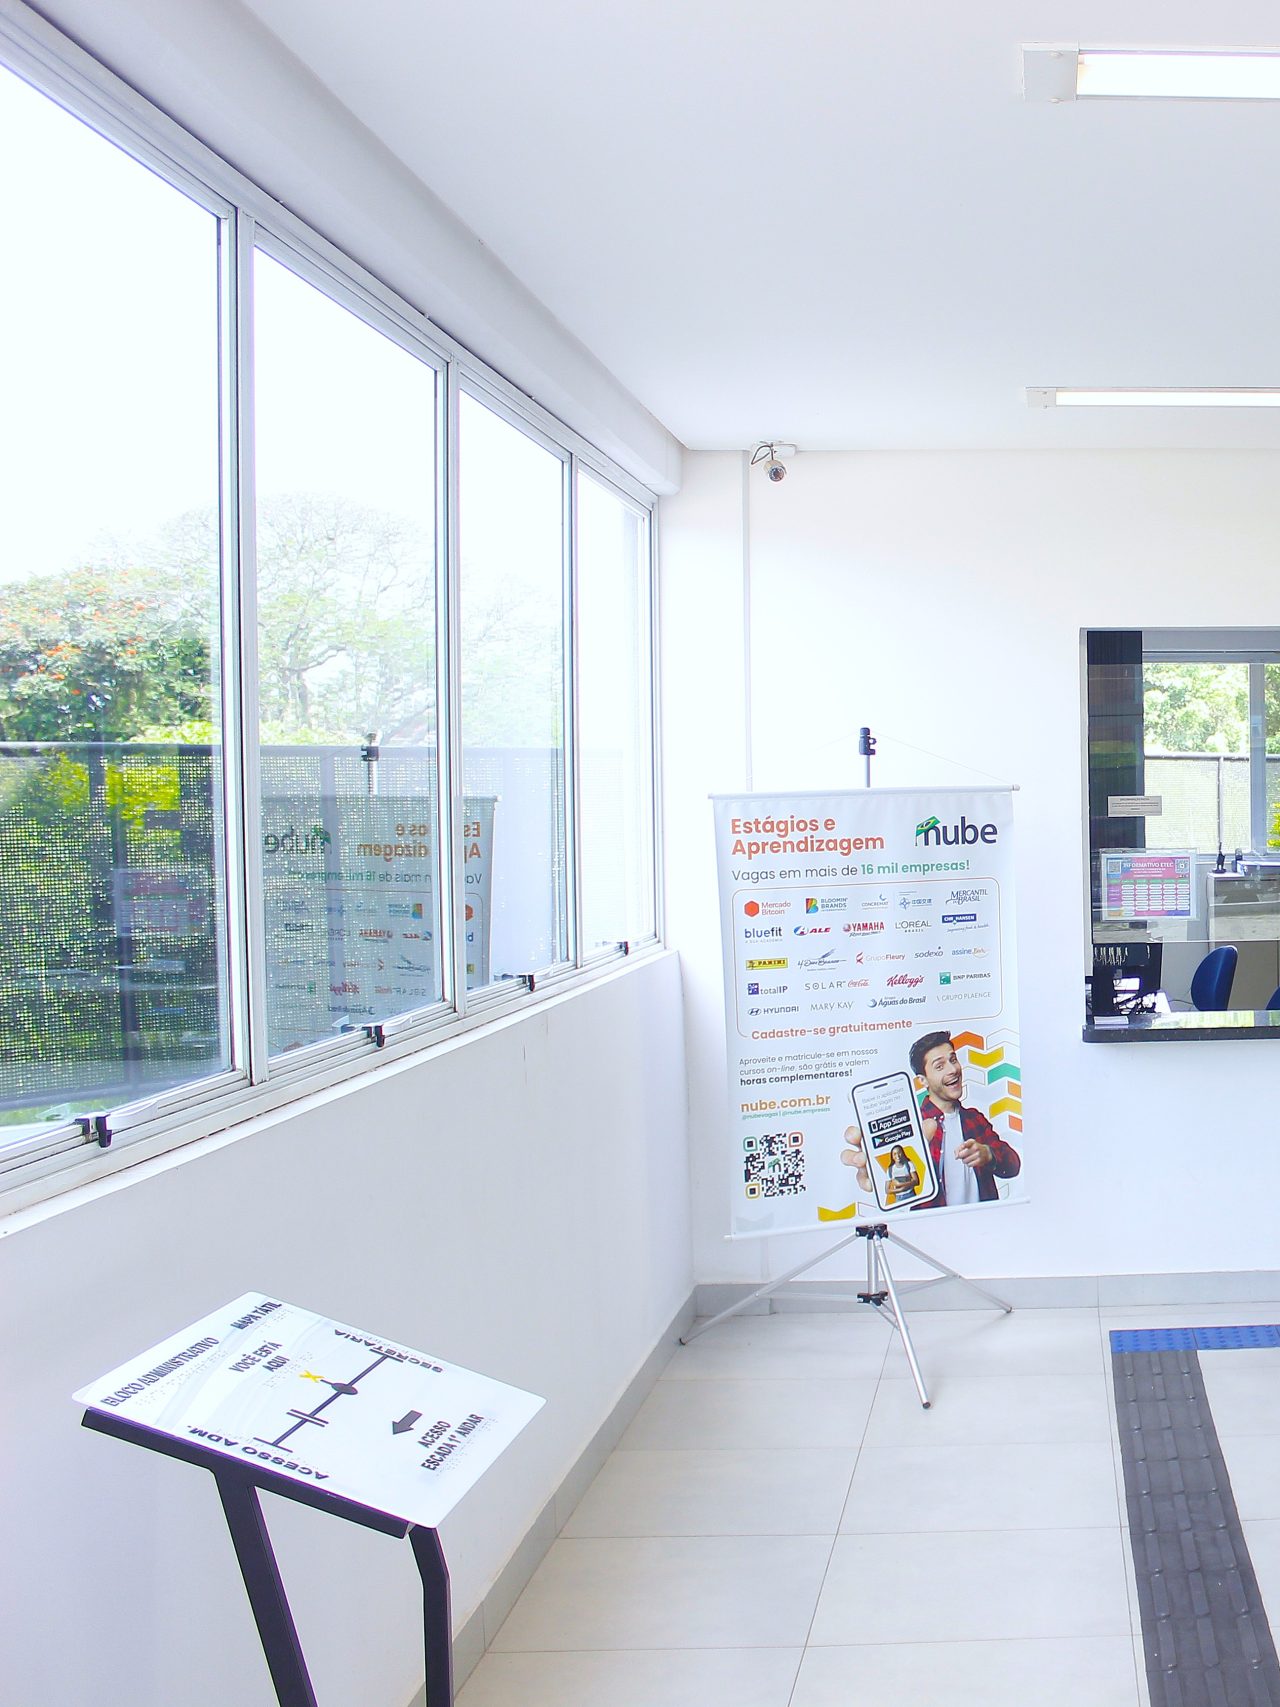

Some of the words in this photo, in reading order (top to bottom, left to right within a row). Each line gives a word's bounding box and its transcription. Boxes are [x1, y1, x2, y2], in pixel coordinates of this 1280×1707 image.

[731, 815, 819, 838] Estágios
[824, 818, 836, 831] e
[922, 816, 998, 846] nube
[731, 835, 885, 860] Aprendizagem
[732, 869, 775, 884] Vagas
[779, 870, 801, 879] em
[805, 865, 837, 878] mais
[841, 864, 858, 876] de
[861, 863, 874, 875] 16
[877, 862, 898, 874] mil
[901, 859, 970, 875] empresas!
[950, 889, 988, 901] MERCANTIL
[761, 901, 791, 909] Mercado
[761, 908, 785, 916] Bitcoin
[745, 927, 782, 938] bluefit
[852, 922, 885, 931] YAMAHA
[914, 947, 943, 958] sodexo
[887, 974, 925, 988] Kellogg's
[810, 1002, 834, 1011] MARY
[837, 1001, 854, 1009] KAY
[899, 997, 908, 1005] do
[908, 996, 926, 1004] Brasil
[763, 1006, 799, 1014] HYUNDAI
[752, 1026, 826, 1039] Cadastre-se
[828, 1020, 913, 1036] gratuitamente
[739, 1056, 777, 1067] Aproveite
[739, 1068, 765, 1076] cursos
[798, 1063, 813, 1071] são
[815, 1060, 837, 1071] grátis
[845, 1058, 870, 1066] valem
[740, 1078, 767, 1086] horas
[769, 1069, 853, 1084] complementares!
[741, 1094, 831, 1112] nube.com.br
[879, 1120, 892, 1130] App
[891, 1116, 907, 1125] Store
[884, 1133, 901, 1143] Google
[230, 1314, 262, 1330] MAPA
[254, 1301, 282, 1316] TÁTIL
[229, 1353, 262, 1373] VOCÊ
[253, 1340, 282, 1358] ESTÁ
[334, 1329, 443, 1373] SECRETARIA
[100, 1382, 145, 1407] BLOCO
[137, 1337, 220, 1386] ADMINISTRATIVO
[262, 1355, 290, 1372] AQUI
[187, 1425, 239, 1447] ADM.
[418, 1421, 451, 1448] ACESSO
[421, 1443, 457, 1470] ESCADA
[455, 1414, 484, 1437] ANDAR
[241, 1446, 329, 1480] ACESSO
